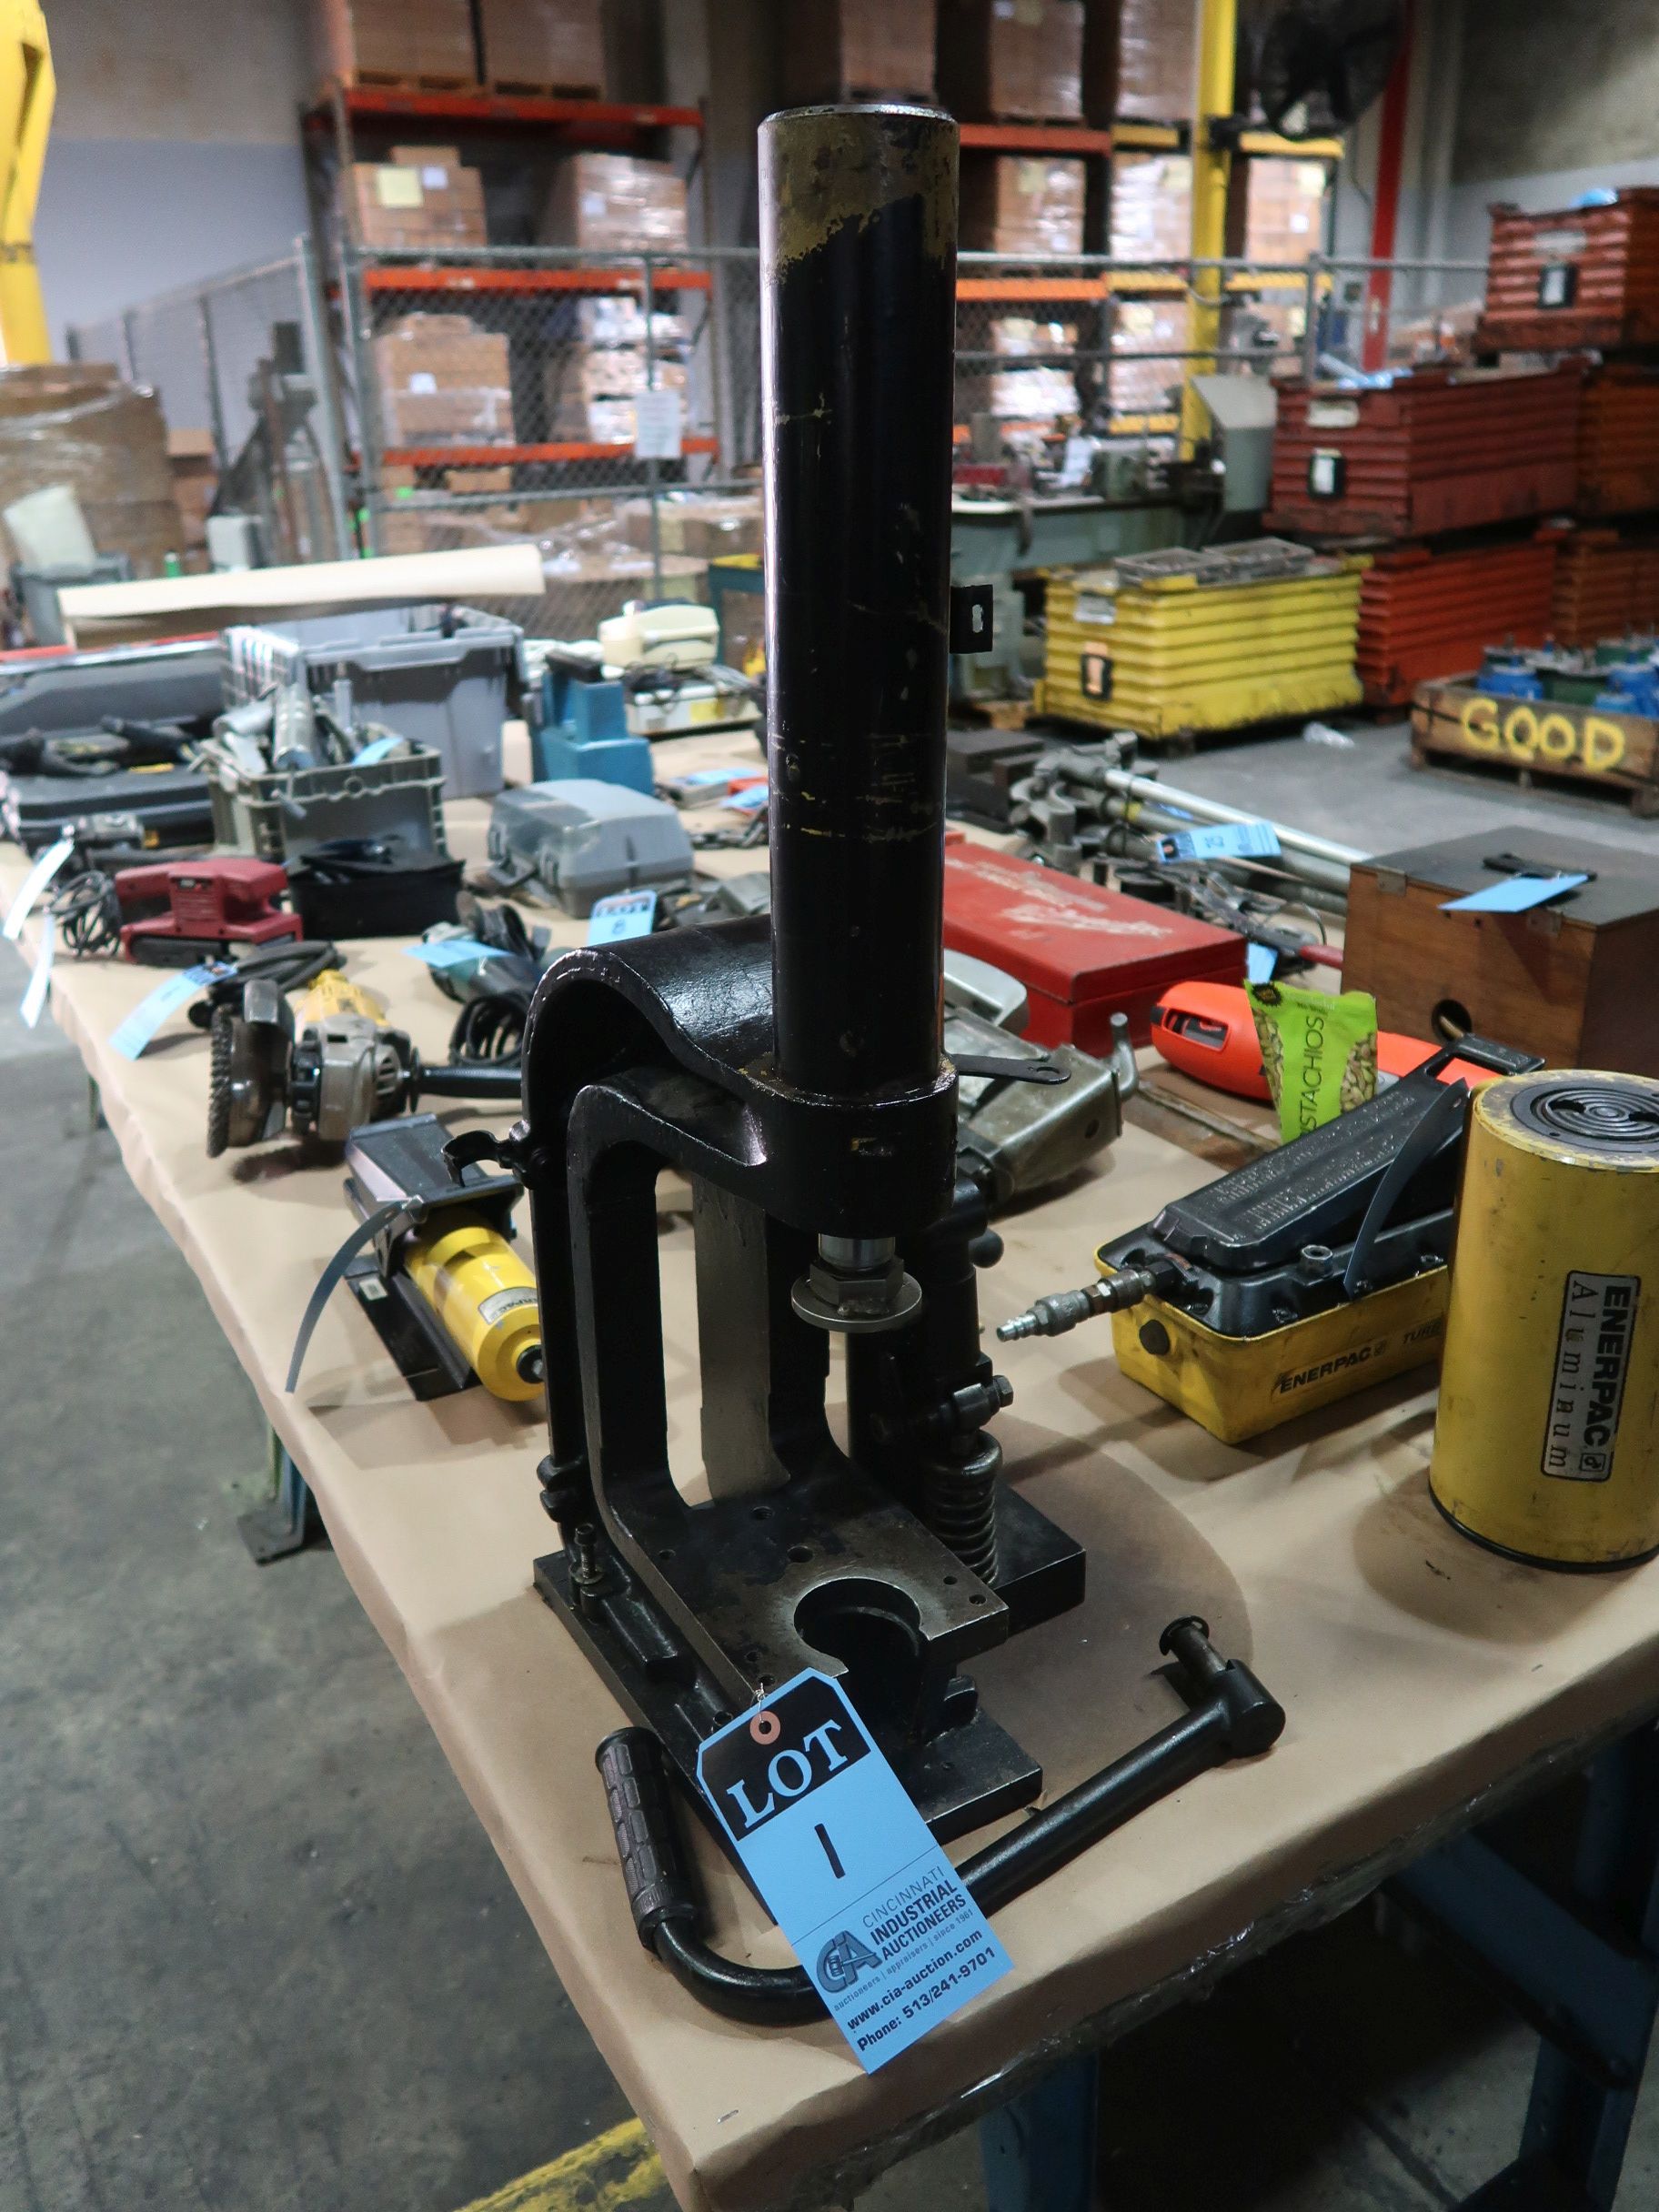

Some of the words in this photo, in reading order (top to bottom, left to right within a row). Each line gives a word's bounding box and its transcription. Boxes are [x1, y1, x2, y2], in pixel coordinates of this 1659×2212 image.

[1462, 698, 1625, 771] GOOD
[1279, 1346, 1372, 1393] ENERPAC
[1548, 1280, 1599, 1468] Aluminum
[1584, 1285, 1632, 1447] ENERPAC
[726, 1718, 849, 1829] LOT
[862, 1865, 946, 1928] CINCINNATI
[870, 1879, 958, 1946] INDUSTRIAL
[881, 1894, 967, 1960] AUCTIONEERS
[834, 1976, 880, 2011] auctioneers
[887, 1942, 929, 1975] appraisers
[933, 1925, 955, 1942] since
[847, 1929, 982, 2030] www.cia-auction.com
[856, 2016, 902, 2051] Phone:
[902, 1946, 996, 2019] 513/241-9701
